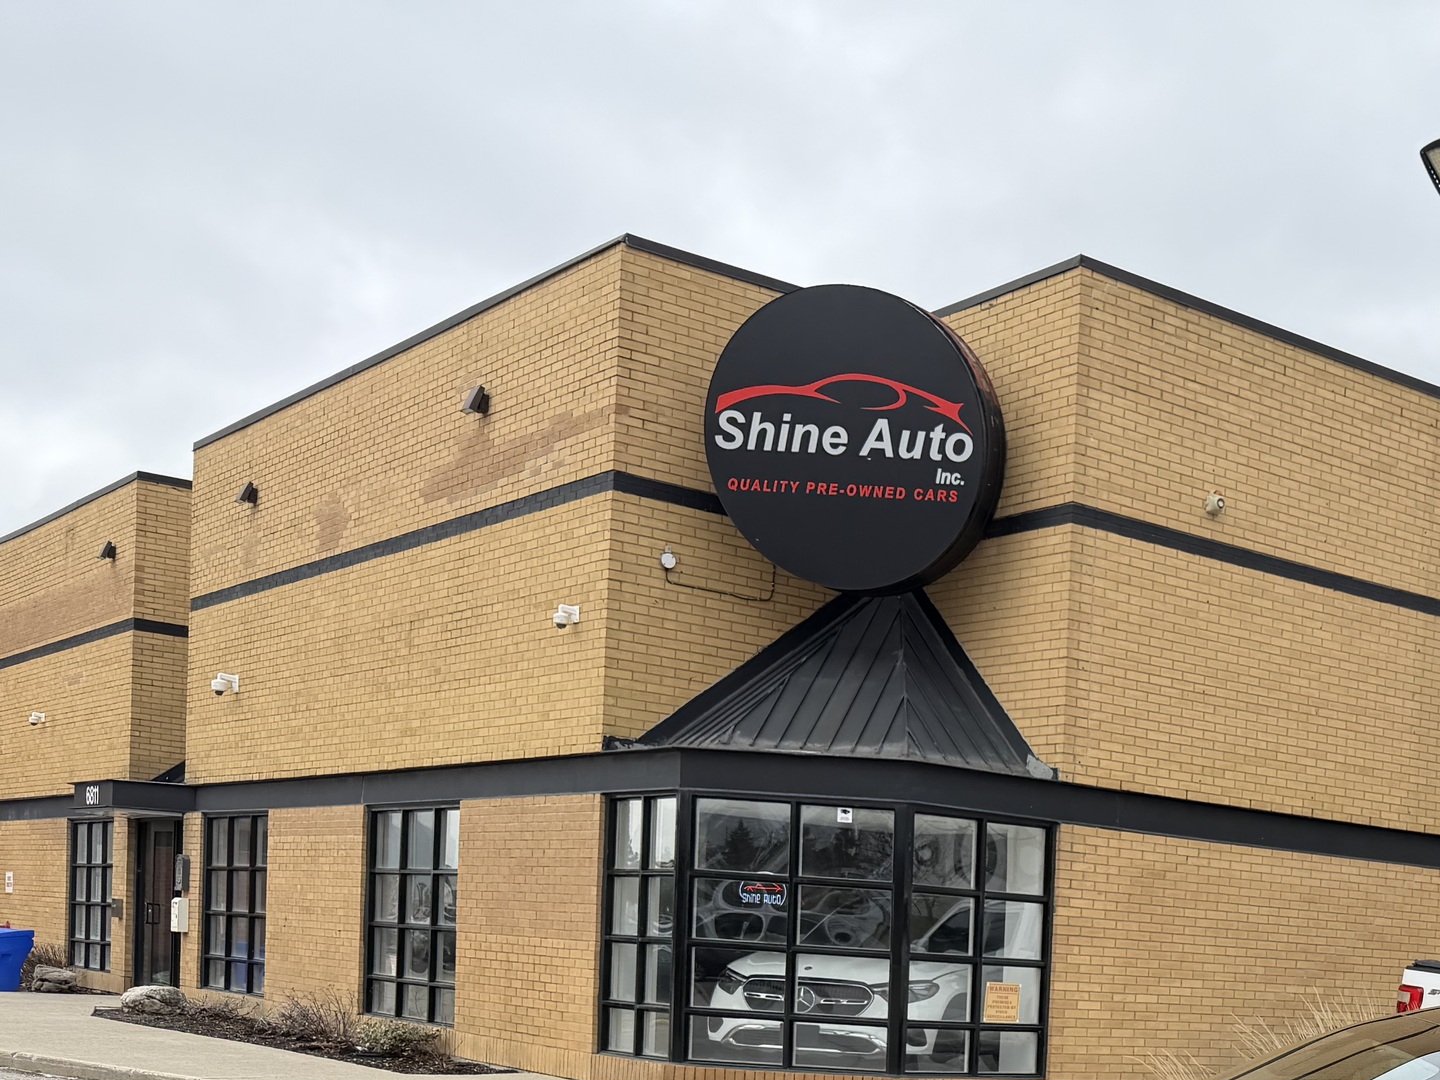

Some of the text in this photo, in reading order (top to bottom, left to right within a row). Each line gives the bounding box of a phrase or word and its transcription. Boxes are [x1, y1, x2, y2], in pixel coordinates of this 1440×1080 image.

[714, 409, 974, 463] Shine Auto
[935, 468, 965, 486] Inc.
[727, 478, 959, 503] QUALITY PRE-OWNED CARS
[85, 785, 99, 805] 6811
[742, 893, 782, 905] Shine Auto
